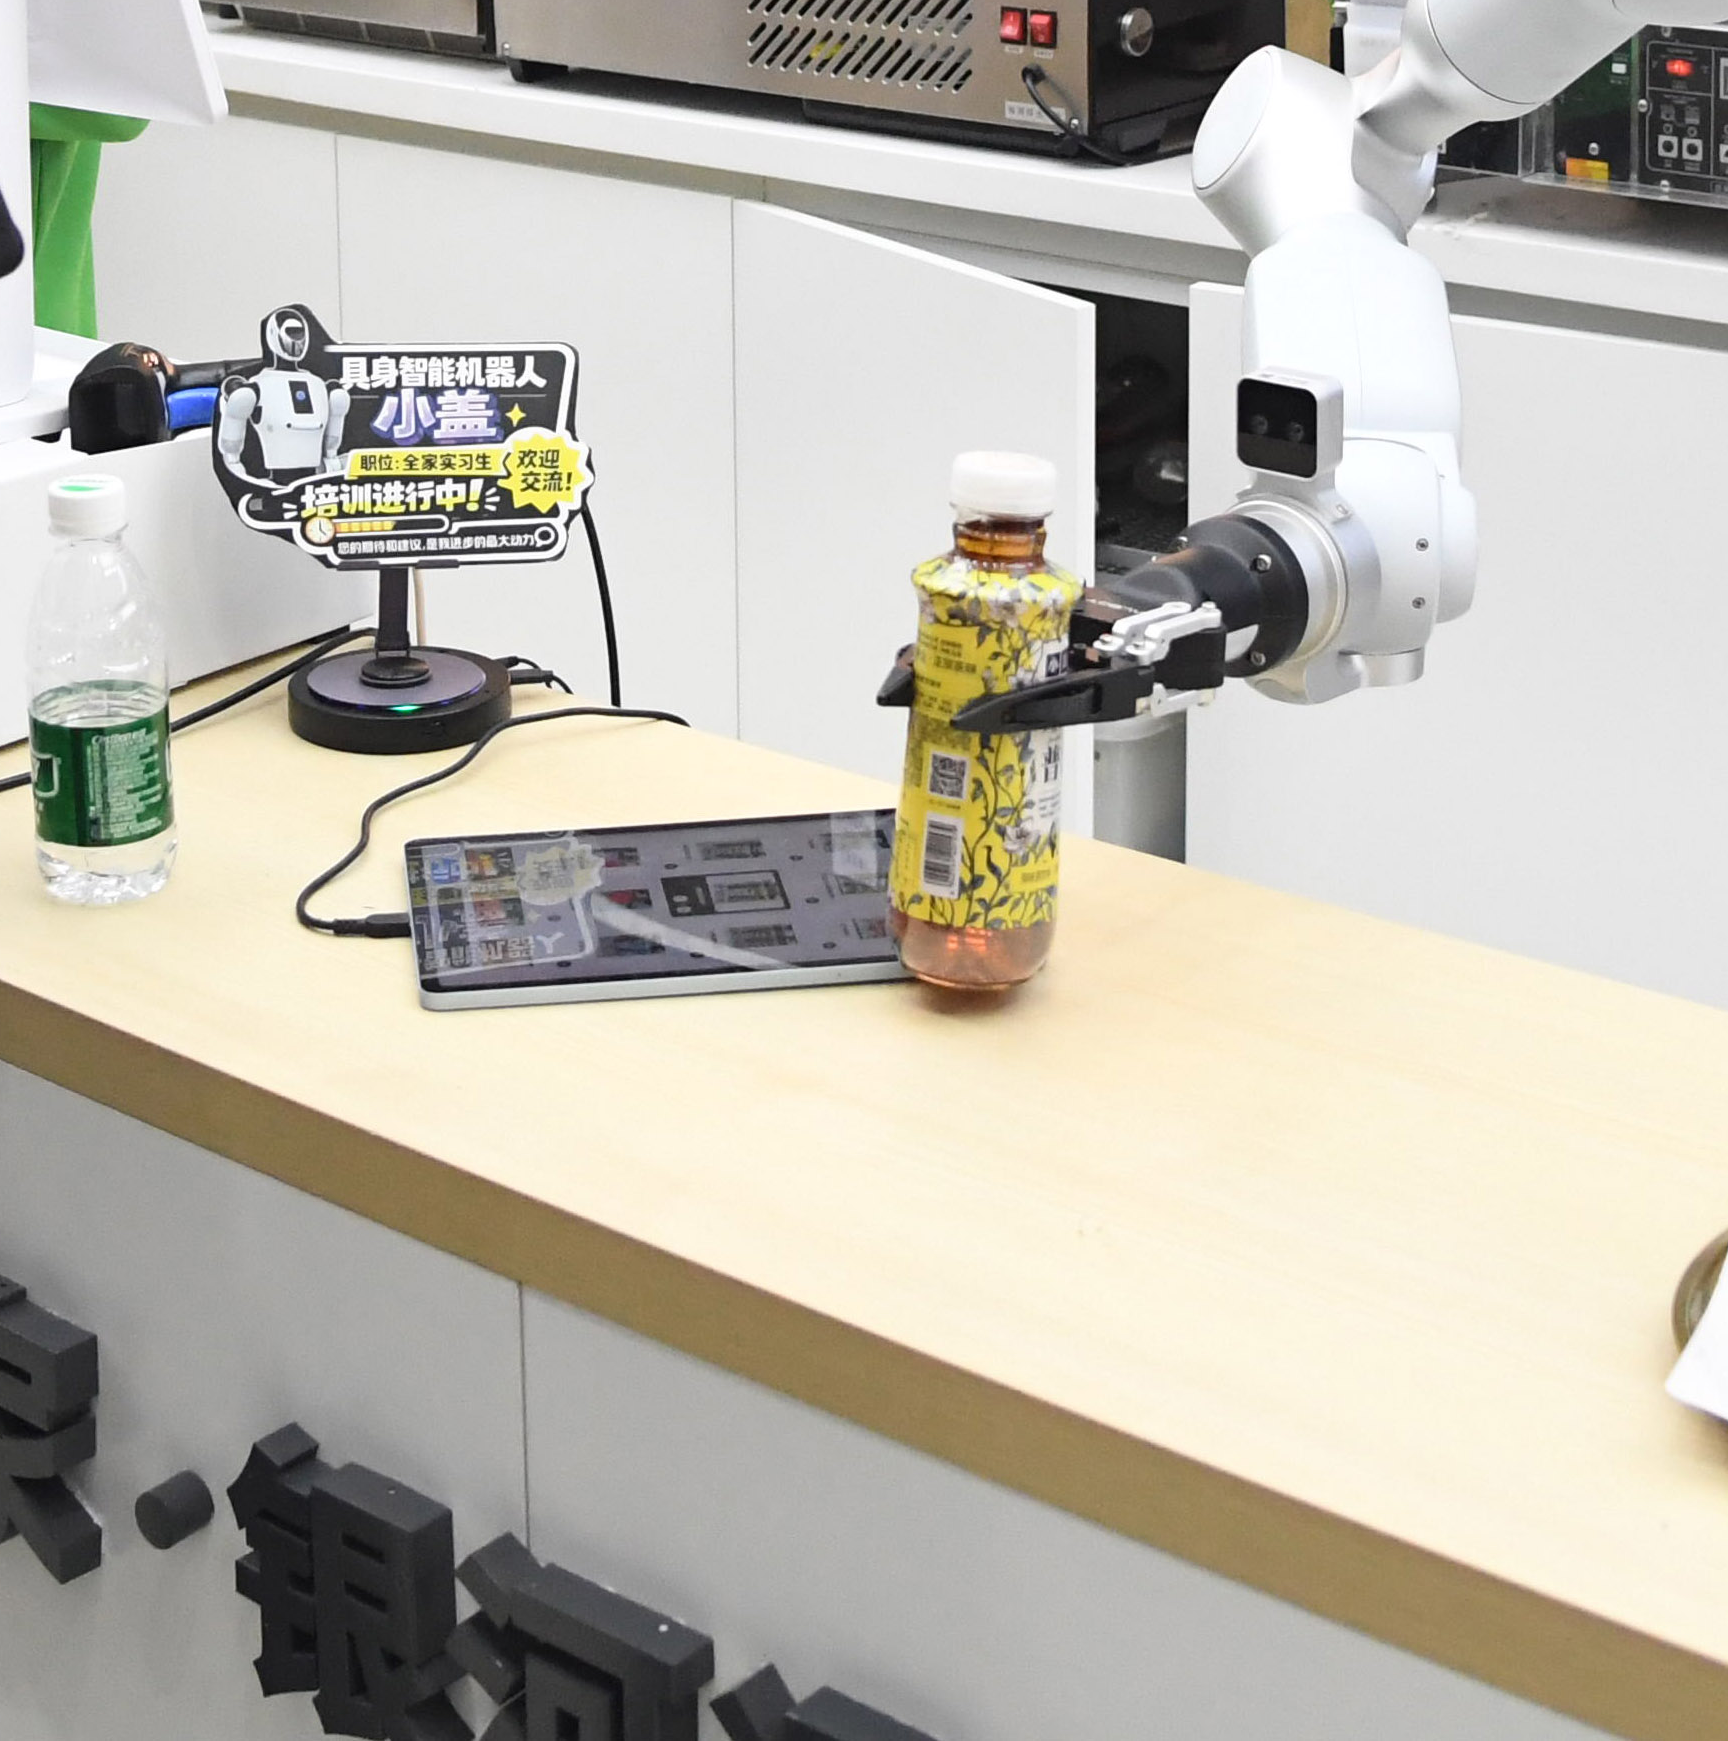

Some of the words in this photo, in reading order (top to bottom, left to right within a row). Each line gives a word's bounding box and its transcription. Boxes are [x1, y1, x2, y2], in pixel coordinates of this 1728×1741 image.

[340, 356, 548, 390] 具身智能机器人
[373, 387, 499, 441] 小盖
[516, 449, 561, 469] 欢迎
[300, 479, 483, 519] 培训进行中!
[521, 471, 573, 493] 交流!
